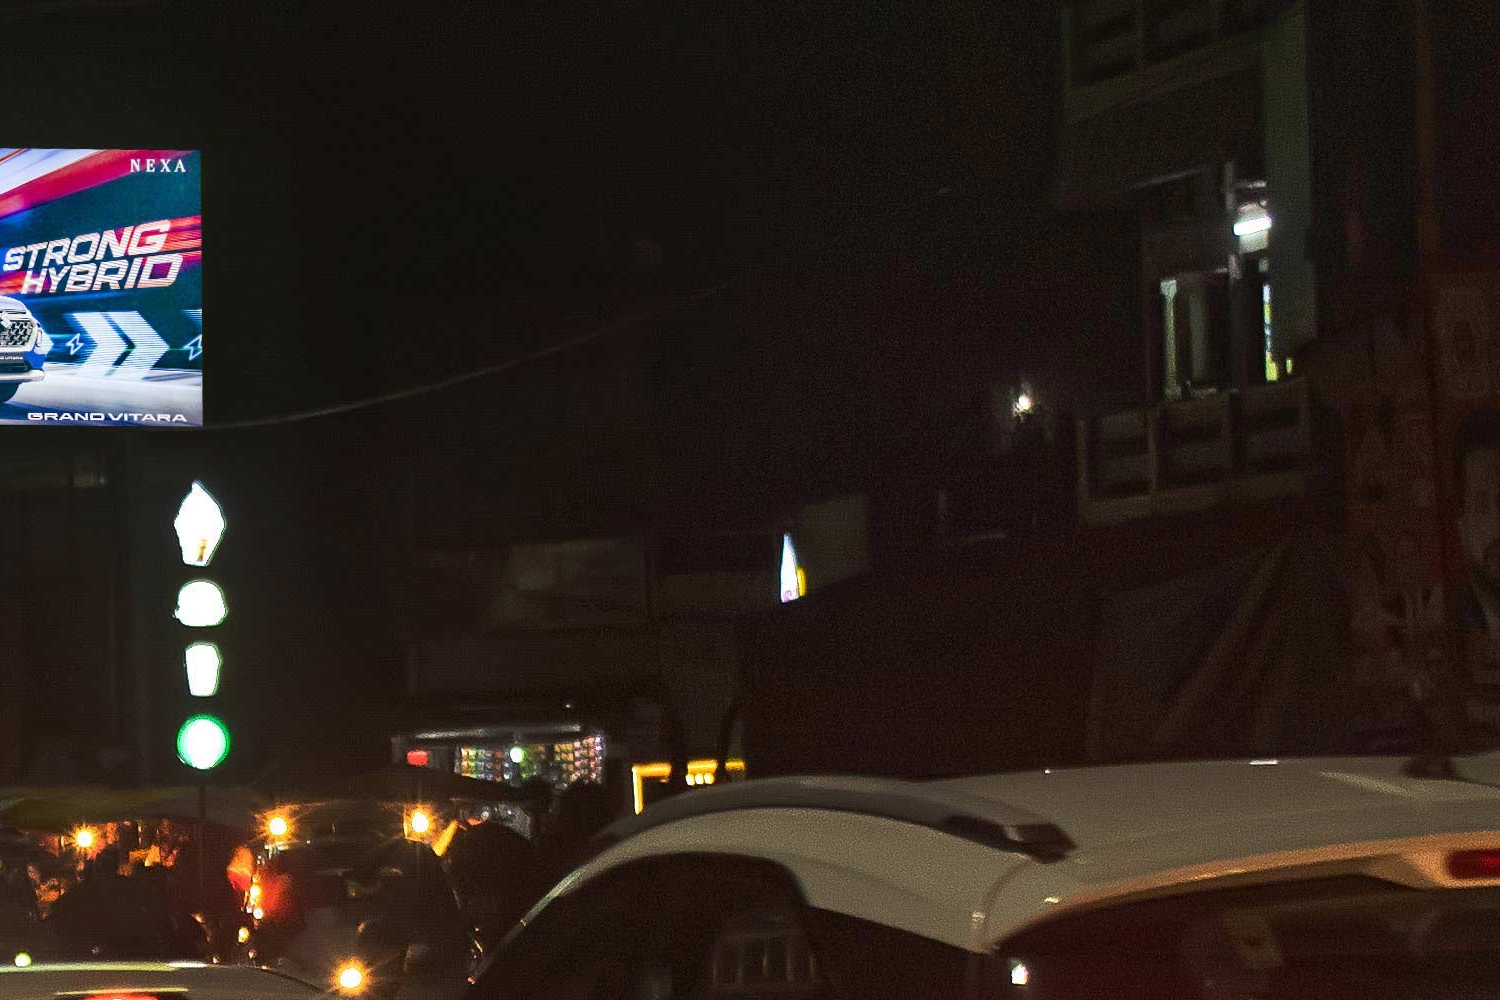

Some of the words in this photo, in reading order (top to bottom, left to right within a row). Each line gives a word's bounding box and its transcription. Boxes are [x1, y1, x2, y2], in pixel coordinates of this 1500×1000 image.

[130, 158, 186, 173] NEXA
[2, 219, 171, 272] STRONG
[20, 253, 184, 295] HYBRID
[27, 412, 104, 421] GRAND
[107, 413, 187, 422] VITARA
